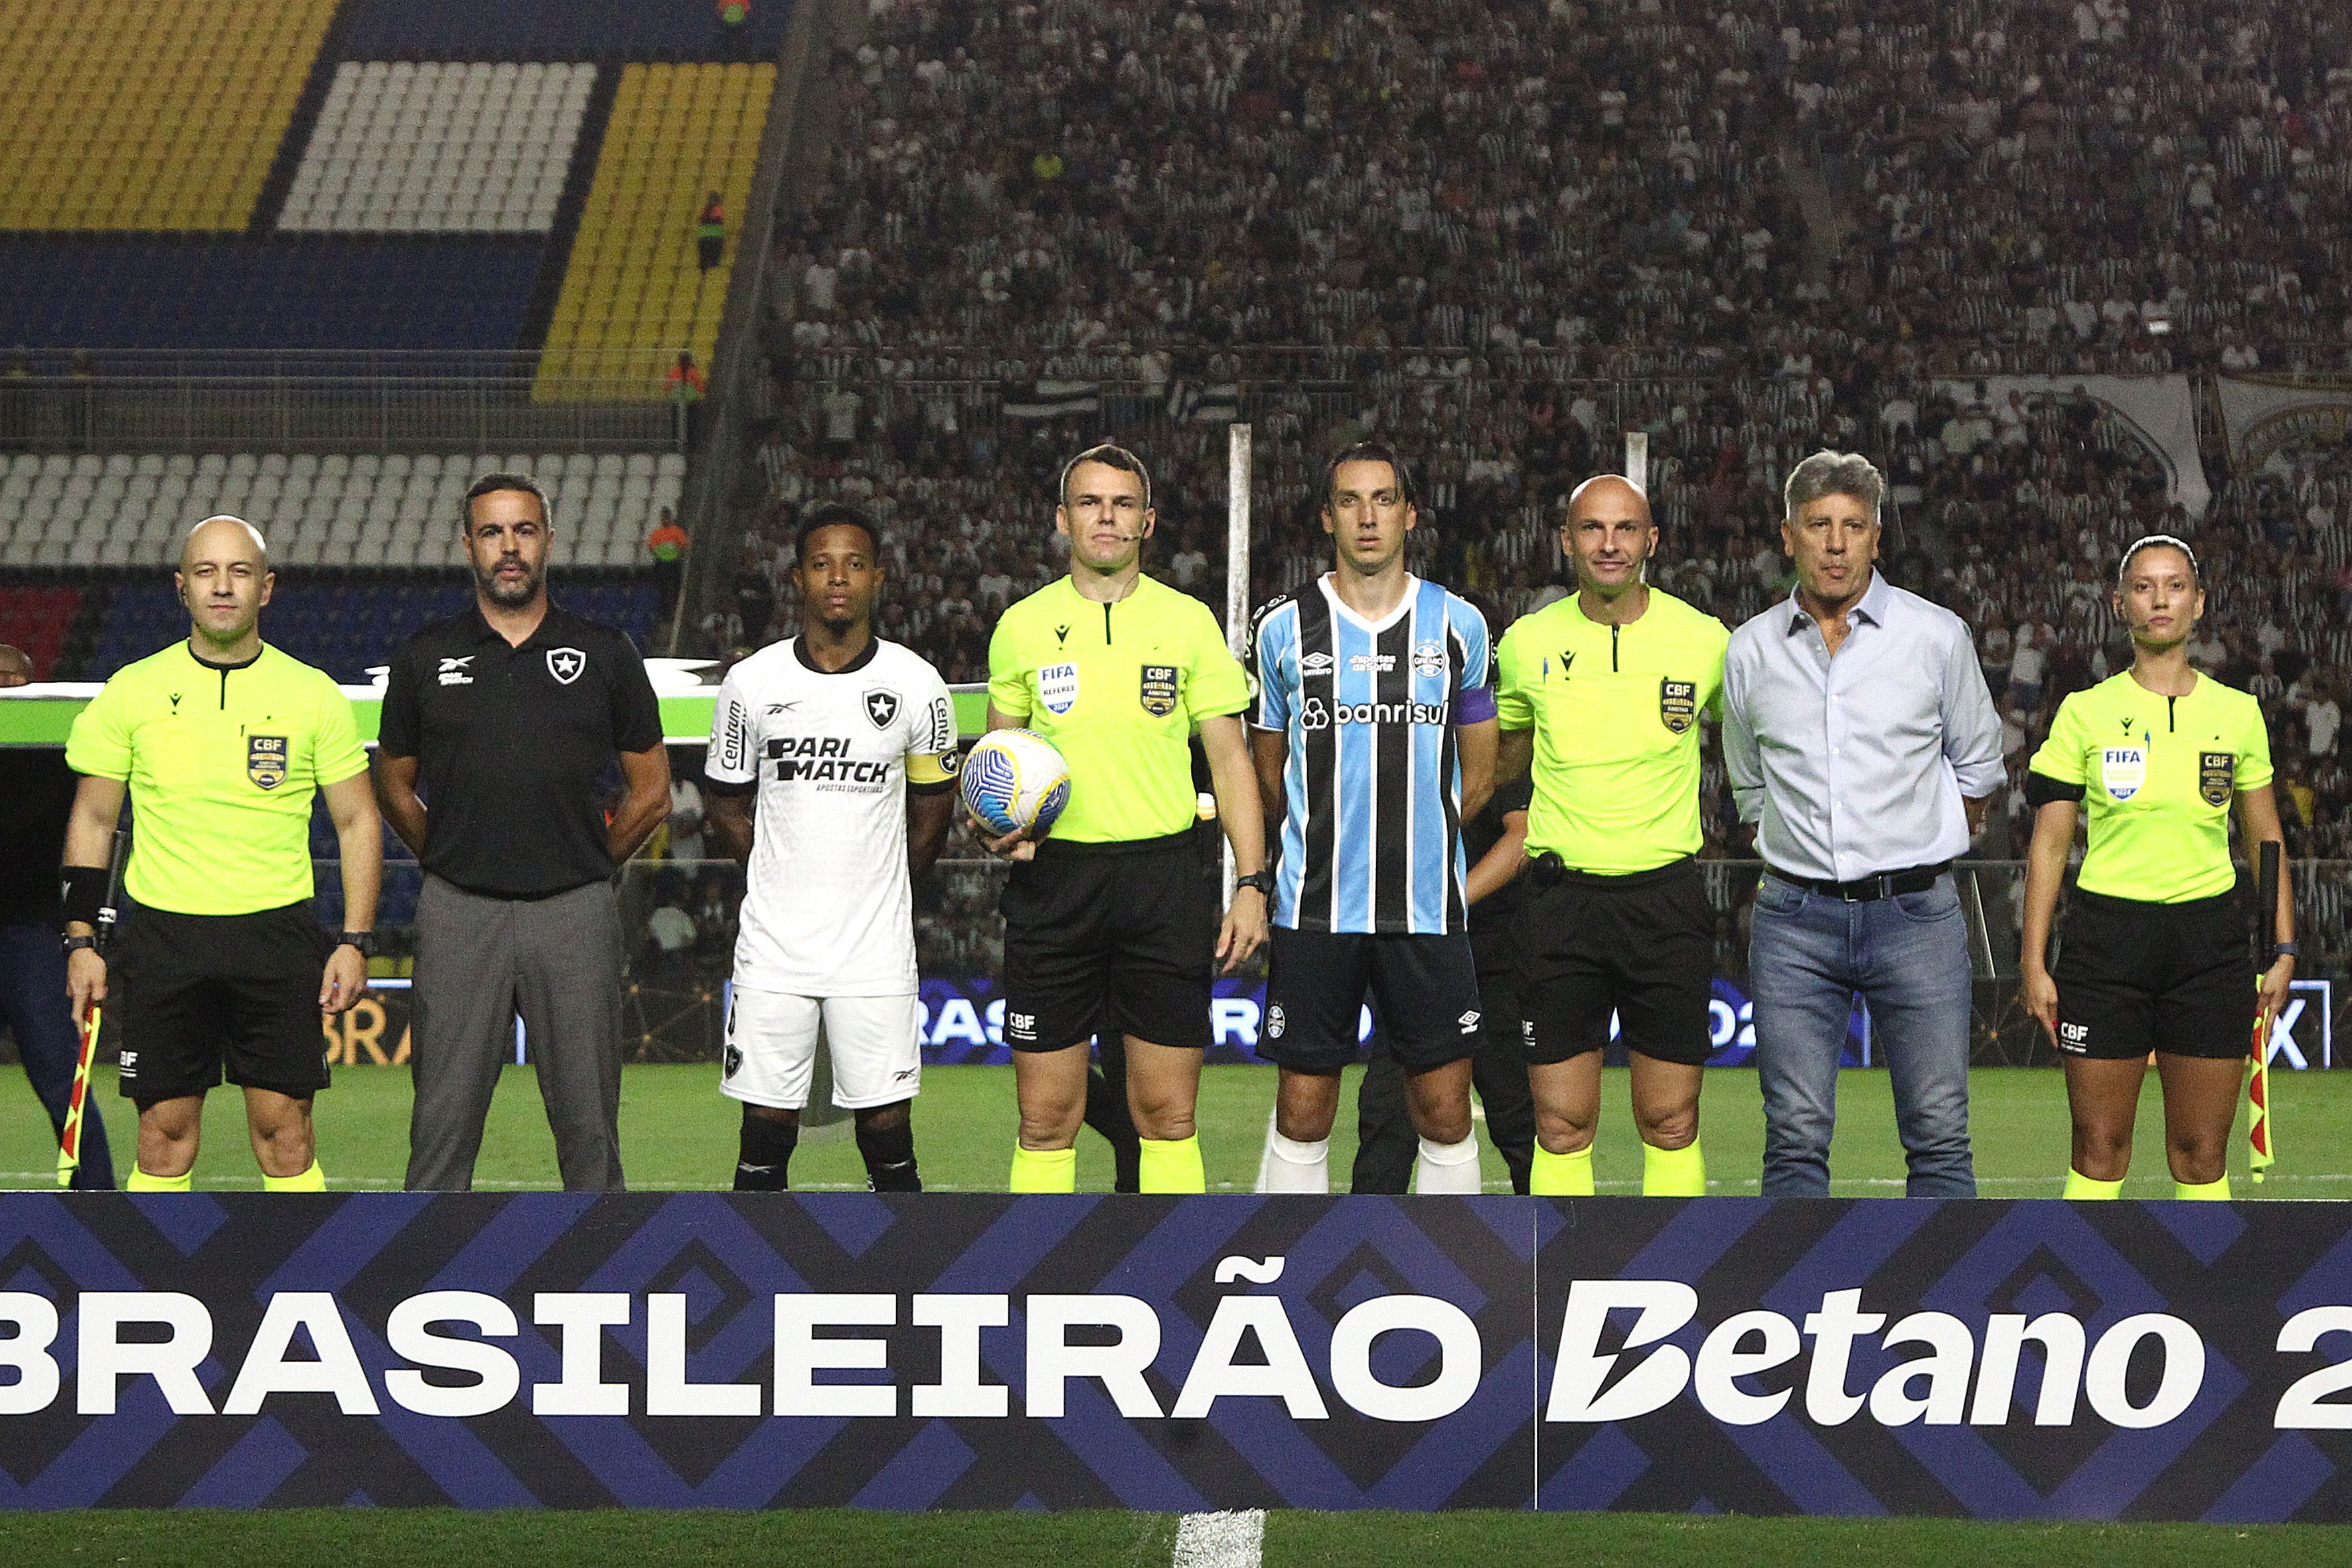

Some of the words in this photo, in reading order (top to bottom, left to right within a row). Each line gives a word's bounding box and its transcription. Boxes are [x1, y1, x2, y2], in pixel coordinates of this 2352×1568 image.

[1042, 665, 1074, 680] FIFA
[1147, 668, 1172, 680] CBF
[1304, 667, 1332, 676] umbro
[1044, 685, 1075, 696] REFEREE
[1666, 684, 1691, 696] CBF
[1334, 698, 1449, 726] banrisul
[936, 697, 949, 750] Centru
[722, 700, 742, 770] Centrum
[254, 738, 282, 751] CBF
[767, 737, 851, 758] PARI
[2106, 750, 2140, 763] FIFA
[2205, 755, 2229, 768] CBF
[777, 760, 890, 783] MATCH
[1010, 1012, 1035, 1030] CBF
[2061, 1022, 2088, 1041] CBF
[1545, 1280, 2205, 1429] Betano
